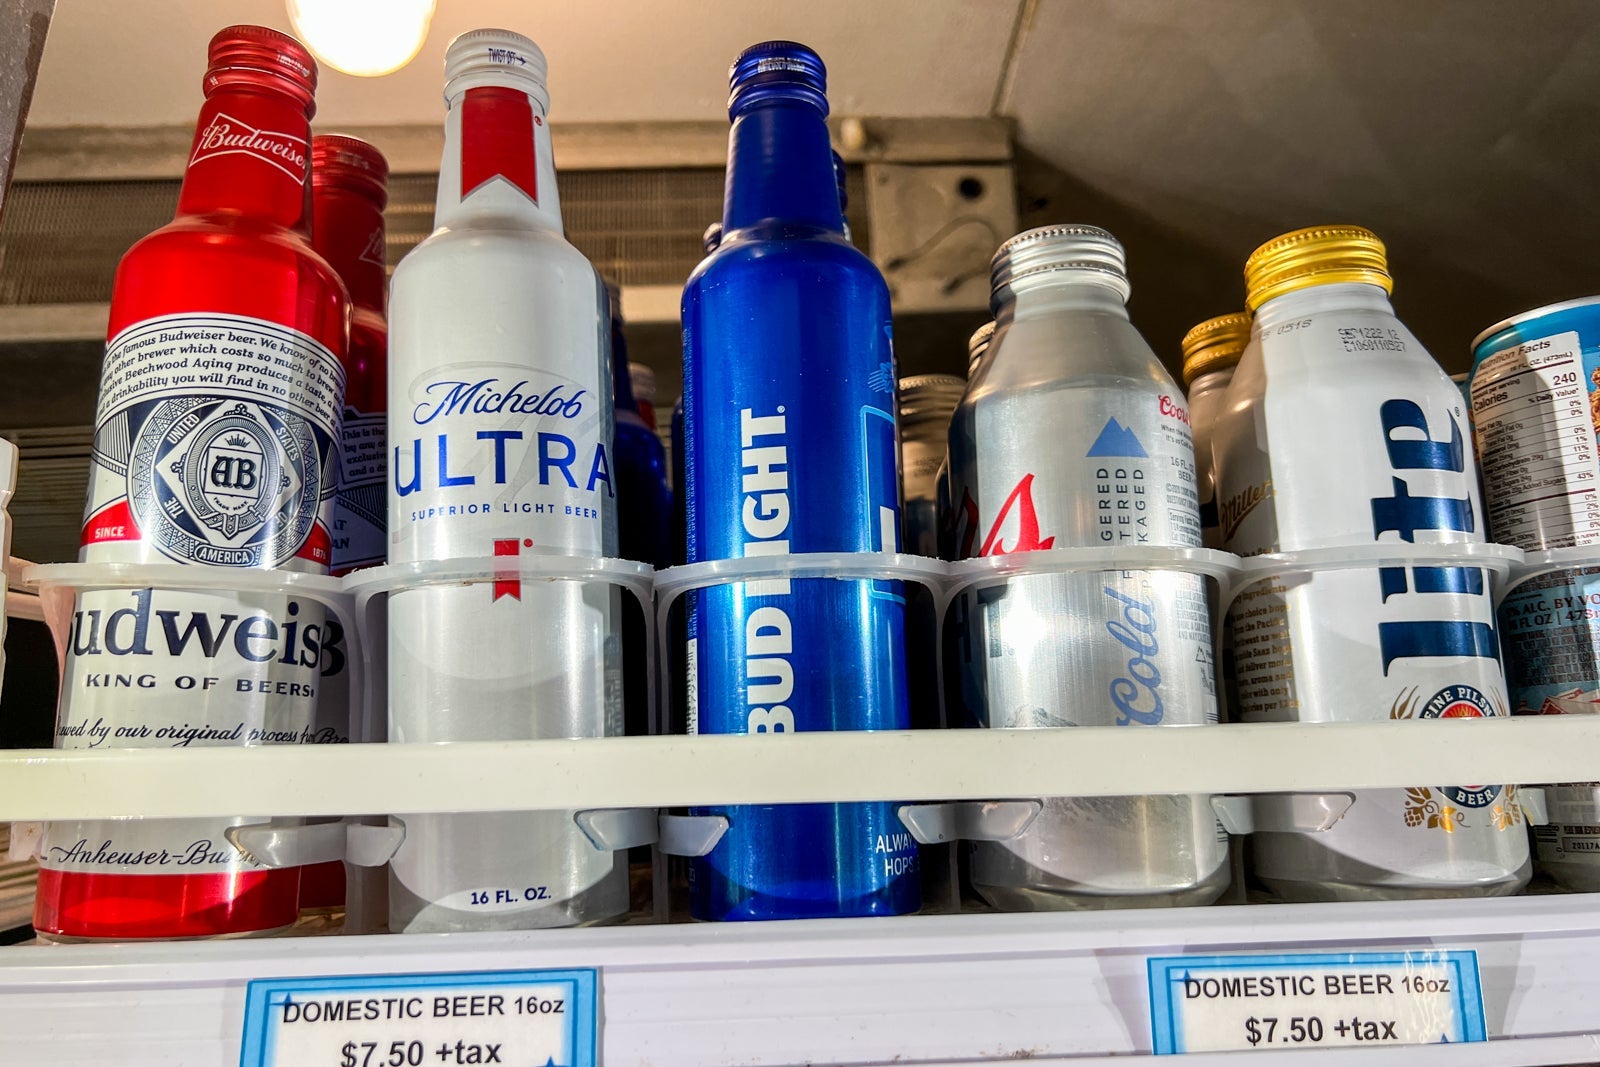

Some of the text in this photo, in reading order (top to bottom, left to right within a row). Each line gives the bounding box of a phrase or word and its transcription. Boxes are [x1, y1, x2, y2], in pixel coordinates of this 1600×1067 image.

[123, 336, 157, 358] famous
[159, 330, 226, 343] Budweiser
[228, 331, 258, 346] beer.
[260, 337, 278, 350] We
[279, 342, 308, 362] know
[309, 358, 321, 368] of
[320, 362, 329, 375] no
[1518, 340, 1552, 354] Facts
[114, 357, 136, 374] other
[138, 347, 176, 363] brewer
[180, 343, 217, 354] which
[221, 346, 254, 359] costs
[258, 353, 272, 362] so
[274, 356, 304, 374] much
[306, 368, 316, 380] to
[316, 374, 336, 395] brew
[124, 358, 188, 382] Beechwood
[236, 362, 294, 384] produces
[296, 380, 302, 388] a
[305, 384, 326, 404] taste,
[328, 400, 333, 408] a
[112, 376, 168, 404] drinkability
[172, 374, 196, 386] you
[200, 372, 224, 384] will
[226, 374, 254, 388] find
[256, 379, 269, 391] in
[272, 384, 287, 396] no
[288, 390, 315, 409] other
[315, 404, 332, 422] beer
[413, 378, 587, 425] Michelob
[1474, 372, 1577, 412] Calories 240
[1536, 394, 1554, 402] Daily
[1158, 394, 1192, 428] Coor
[1570, 408, 1583, 416] 0%
[166, 413, 200, 445] UNITED
[276, 426, 300, 462] STATES
[1574, 426, 1586, 434] 0%
[1573, 444, 1590, 452] 11%
[394, 430, 615, 498] ULTRA
[164, 496, 184, 520] THE
[213, 496, 248, 512] TRADE MARK
[412, 503, 598, 522] SUPERIOR LIGHT BEER
[1097, 468, 1113, 542] GERED
[1116, 468, 1132, 541] TERED
[1133, 468, 1148, 543] KAGED
[94, 525, 125, 539] SINCE
[198, 547, 250, 564] AMERICA
[740, 407, 795, 735] BUD LIGHT
[1523, 594, 1600, 614] ALC. BY VO
[67, 586, 320, 670] udweis
[1518, 614, 1553, 628] FL OZ
[86, 673, 157, 689] KING
[174, 676, 220, 690] OF
[1424, 686, 1493, 719] FINE PILSN
[88, 717, 112, 747] by
[114, 724, 154, 740] our
[155, 722, 244, 748] original
[246, 726, 298, 748] process
[1456, 788, 1494, 805] BEER
[471, 886, 552, 905] 16 FL. OZ.
[1185, 974, 1451, 1000] DOMESTIC BEER 16oz
[283, 994, 566, 1024] DOMESTIC BEER 16oz
[1245, 1015, 1399, 1048] $7.50 +tax
[340, 1038, 502, 1067] $7.50 +tax
